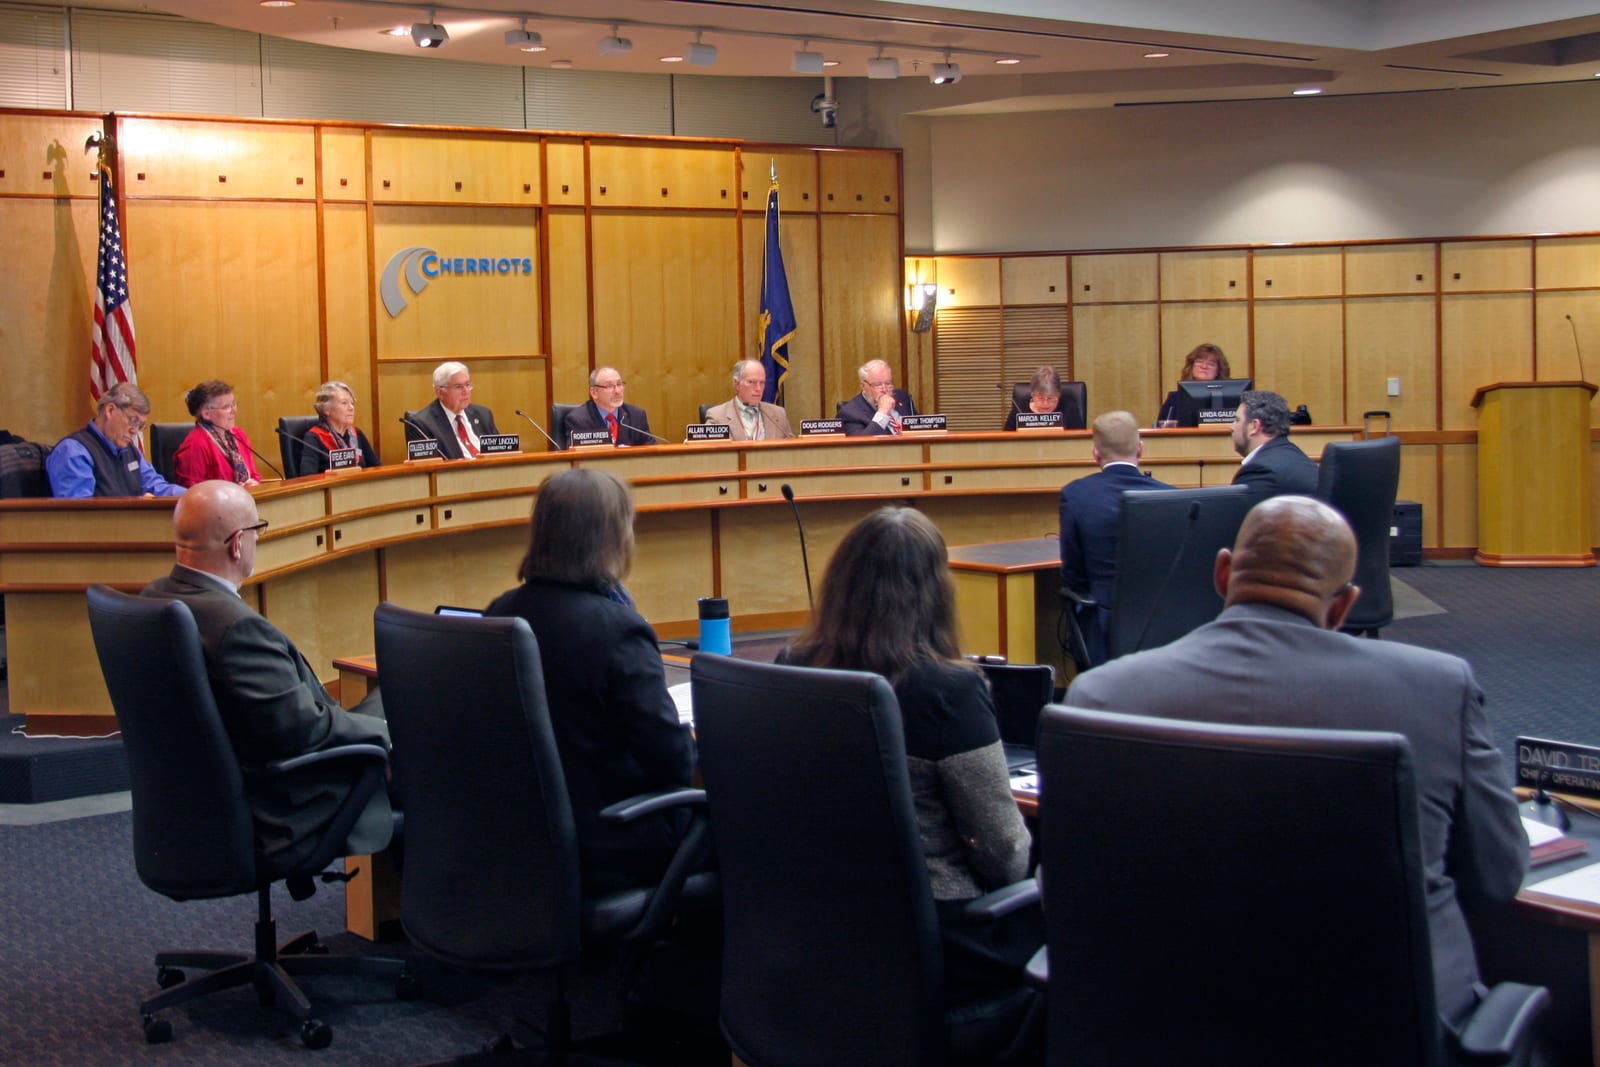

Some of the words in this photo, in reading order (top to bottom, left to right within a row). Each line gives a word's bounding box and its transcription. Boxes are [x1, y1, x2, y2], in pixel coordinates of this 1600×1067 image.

[422, 255, 532, 276] CHERRIOTS
[1039, 414, 1060, 422] KELLEY
[1199, 410, 1217, 418] LINDA
[919, 416, 945, 424] THOMPSON
[688, 426, 705, 434] ALLAN
[705, 426, 729, 434] POLLOCK
[573, 432, 592, 440] ROBERT
[592, 431, 609, 439] KREBS
[481, 438, 497, 446] KATHY
[498, 437, 518, 445] LINCOLN
[409, 443, 425, 452] COLLEEN
[1520, 745, 1569, 768] DAVID
